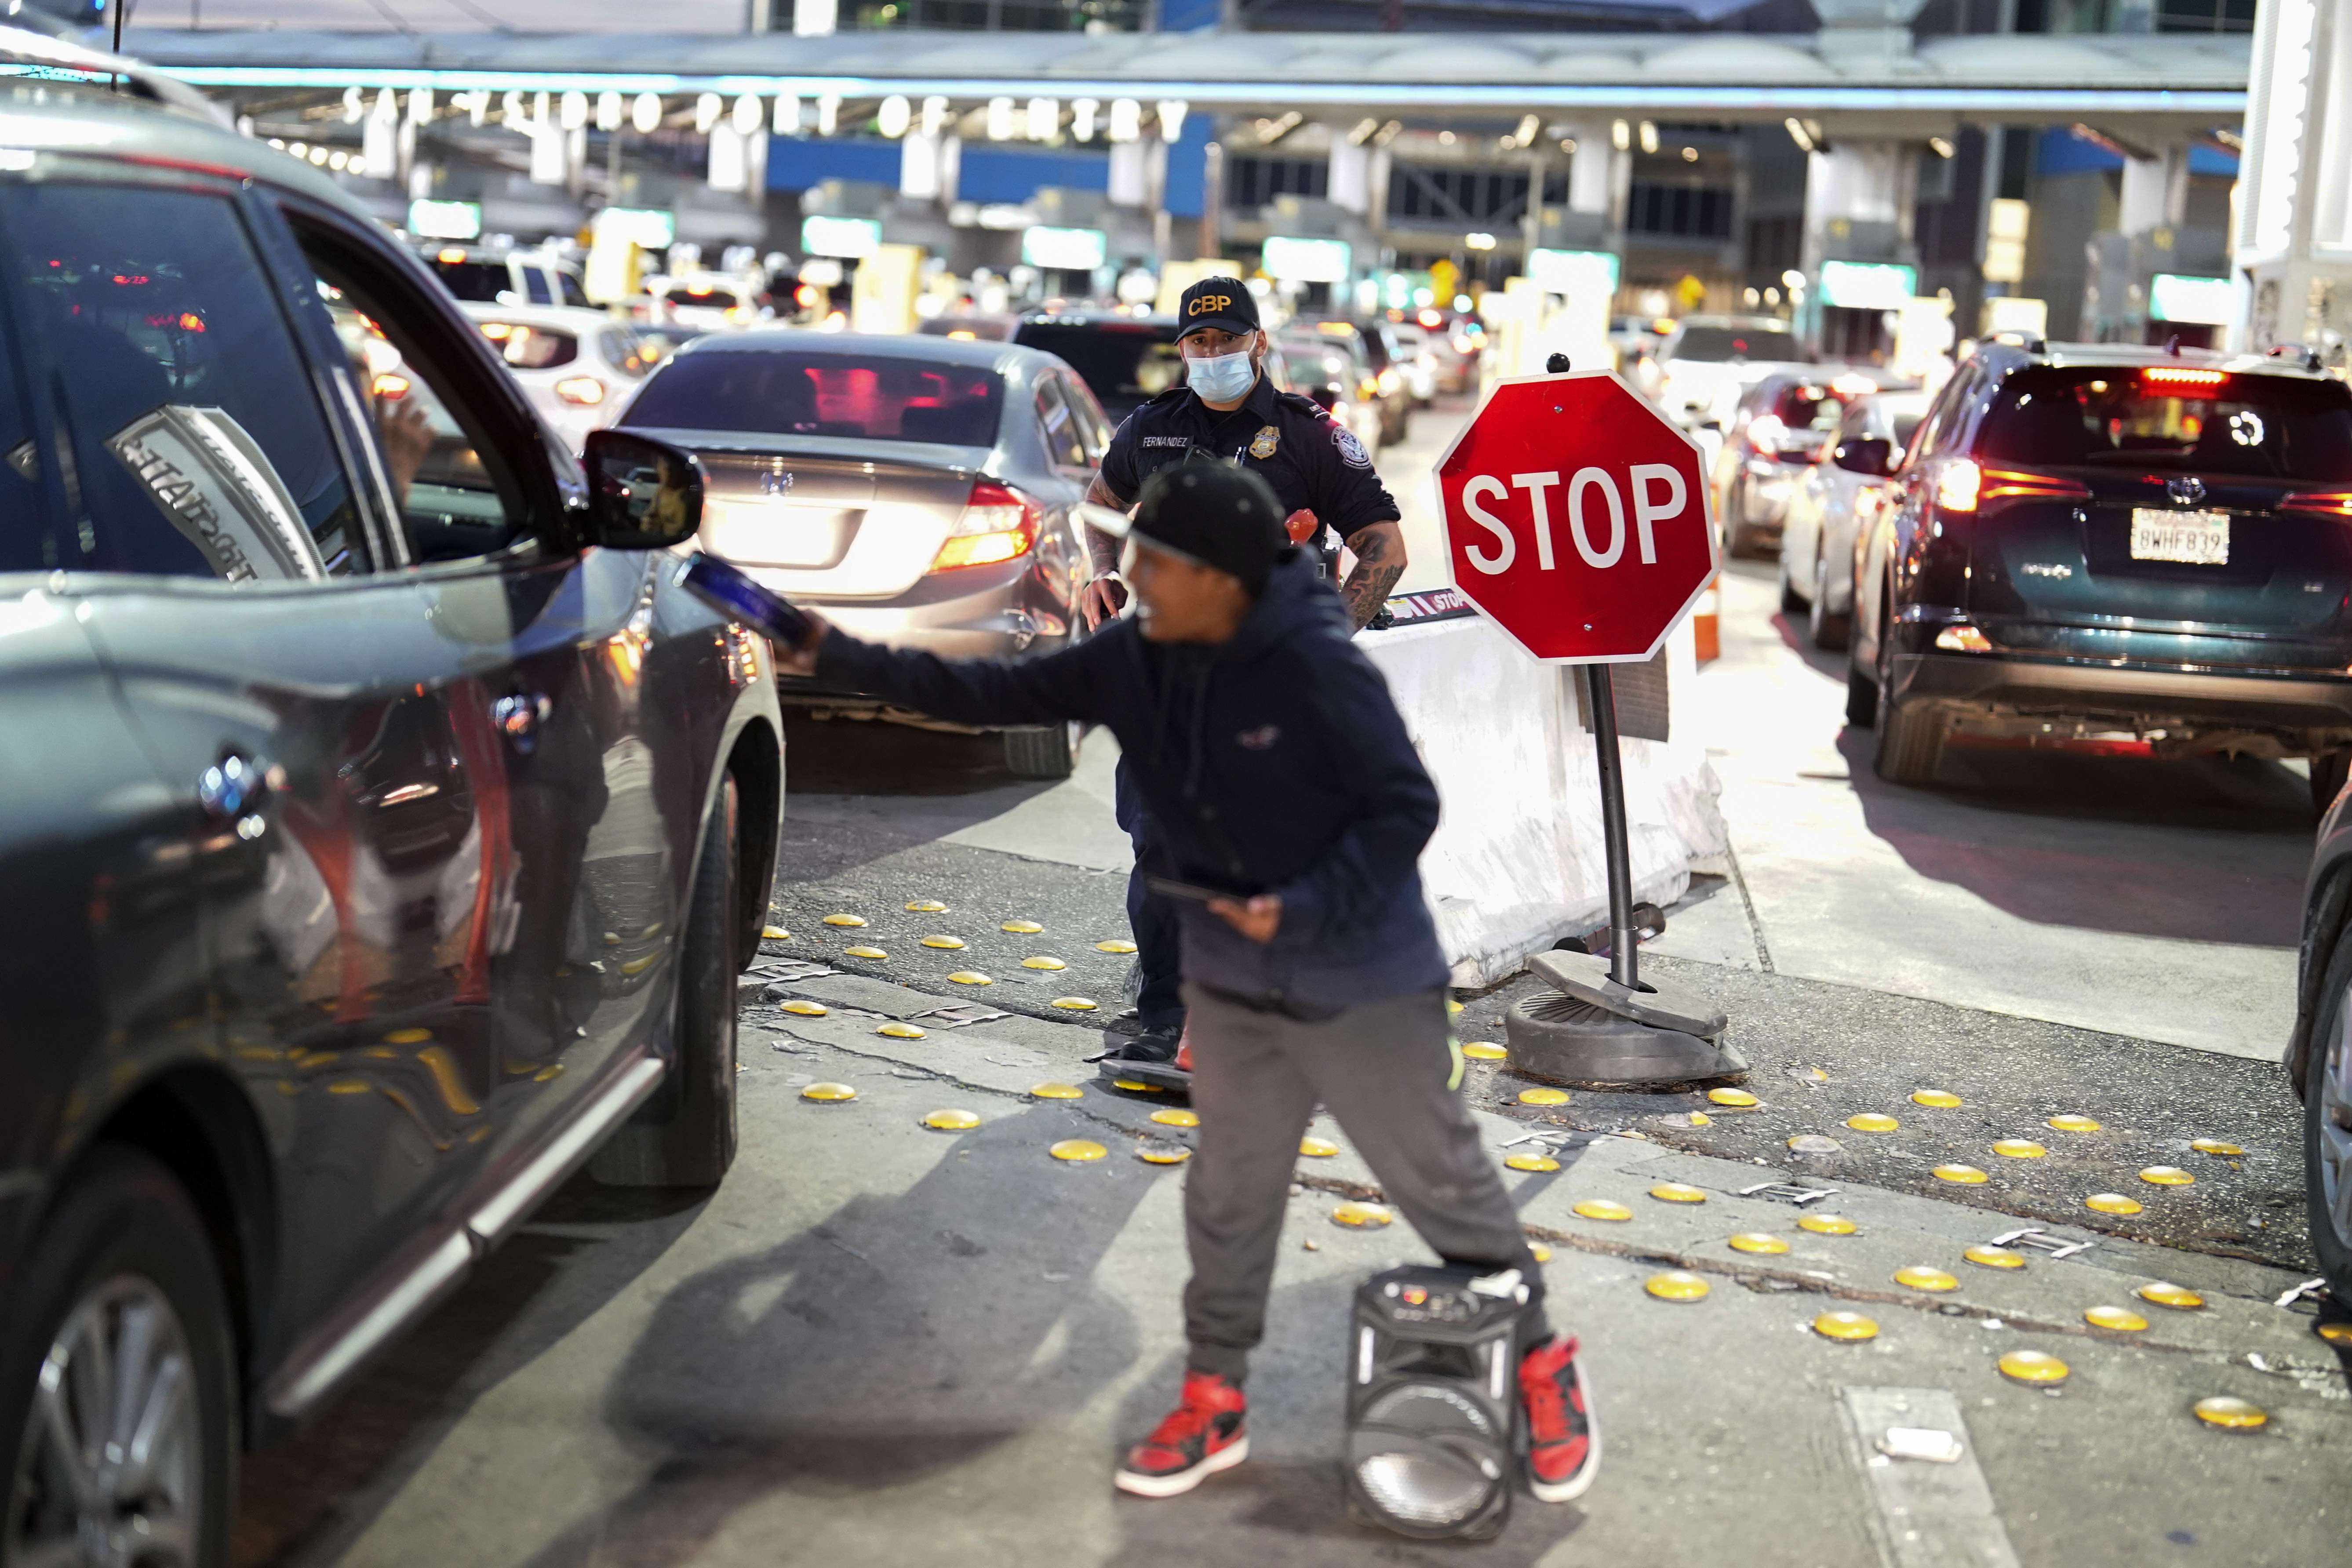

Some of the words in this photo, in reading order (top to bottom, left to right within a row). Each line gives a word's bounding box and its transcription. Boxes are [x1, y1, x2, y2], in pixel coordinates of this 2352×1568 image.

[1188, 295, 1231, 316] CBP
[1143, 437, 1187, 447] FERNANDEZ
[1462, 464, 1687, 575] STOP
